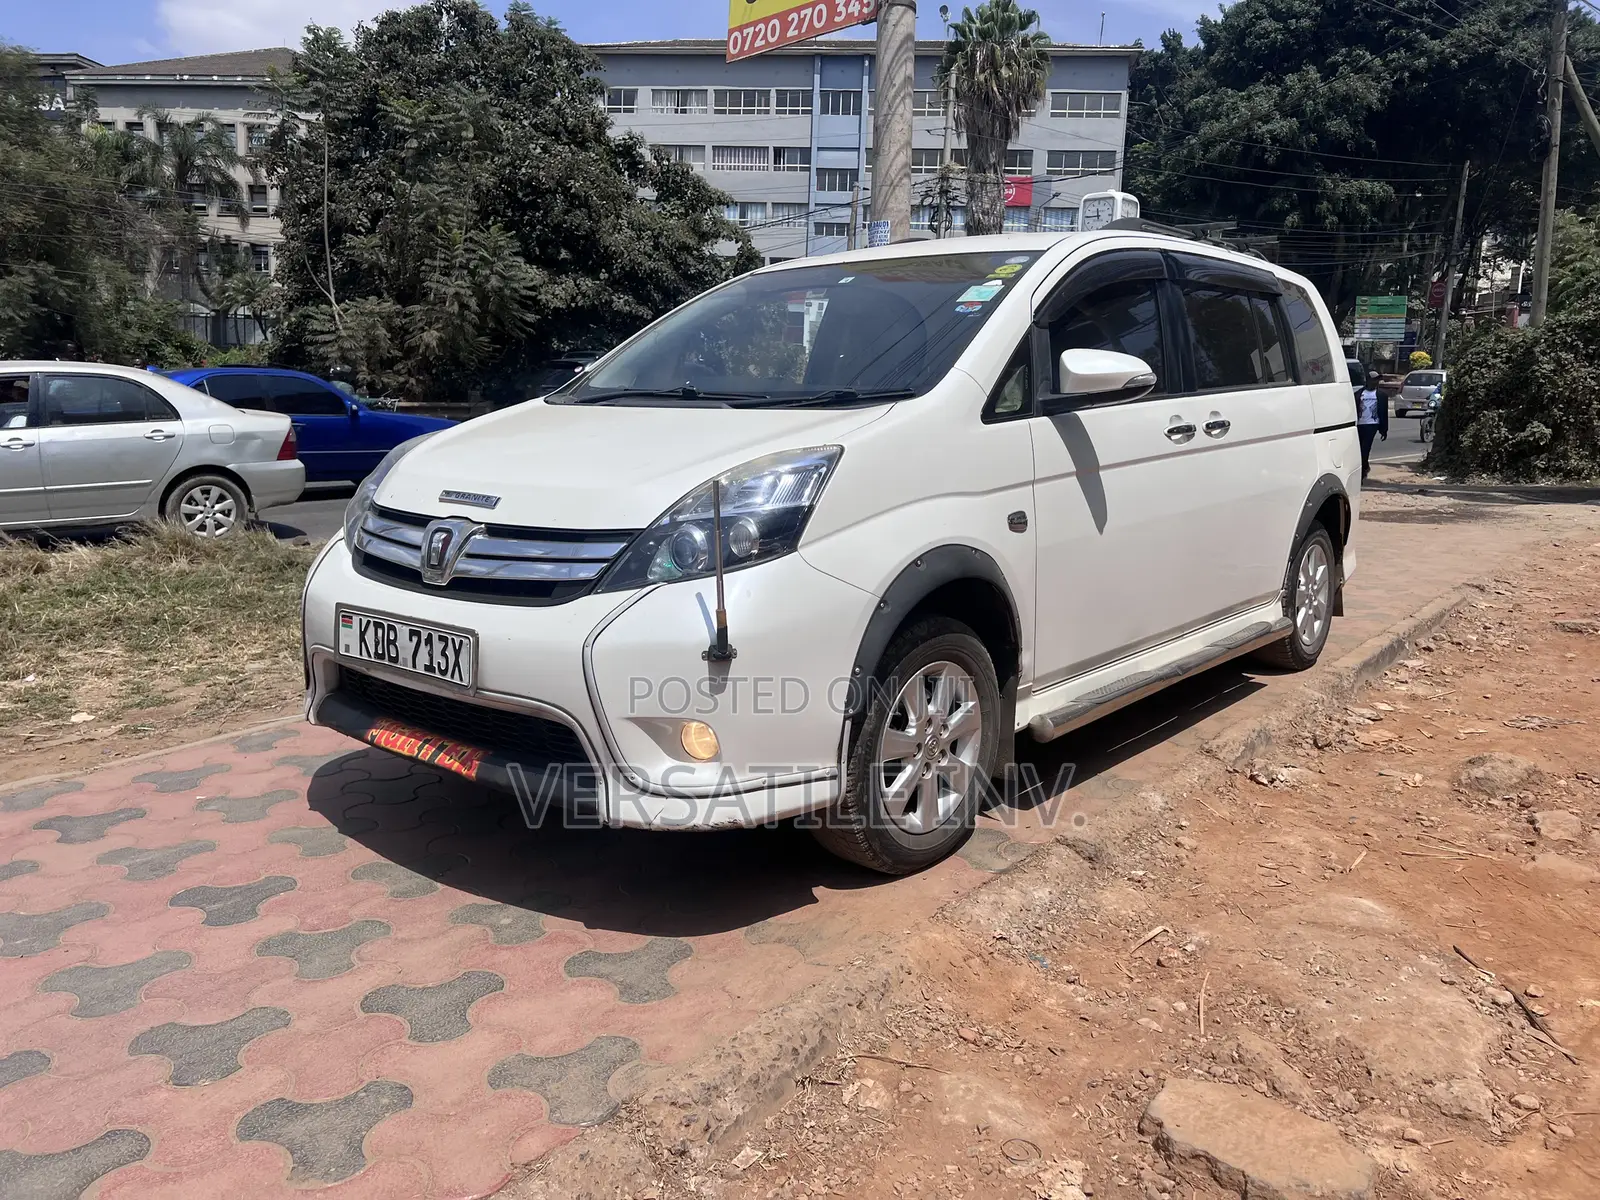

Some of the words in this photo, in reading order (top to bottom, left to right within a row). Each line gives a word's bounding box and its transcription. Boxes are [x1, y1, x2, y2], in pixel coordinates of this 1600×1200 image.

[729, 19, 780, 55] 0720
[786, 3, 827, 38] 270
[454, 492, 491, 503] GRANITE
[358, 616, 400, 664] KDB
[408, 628, 464, 682] 713X
